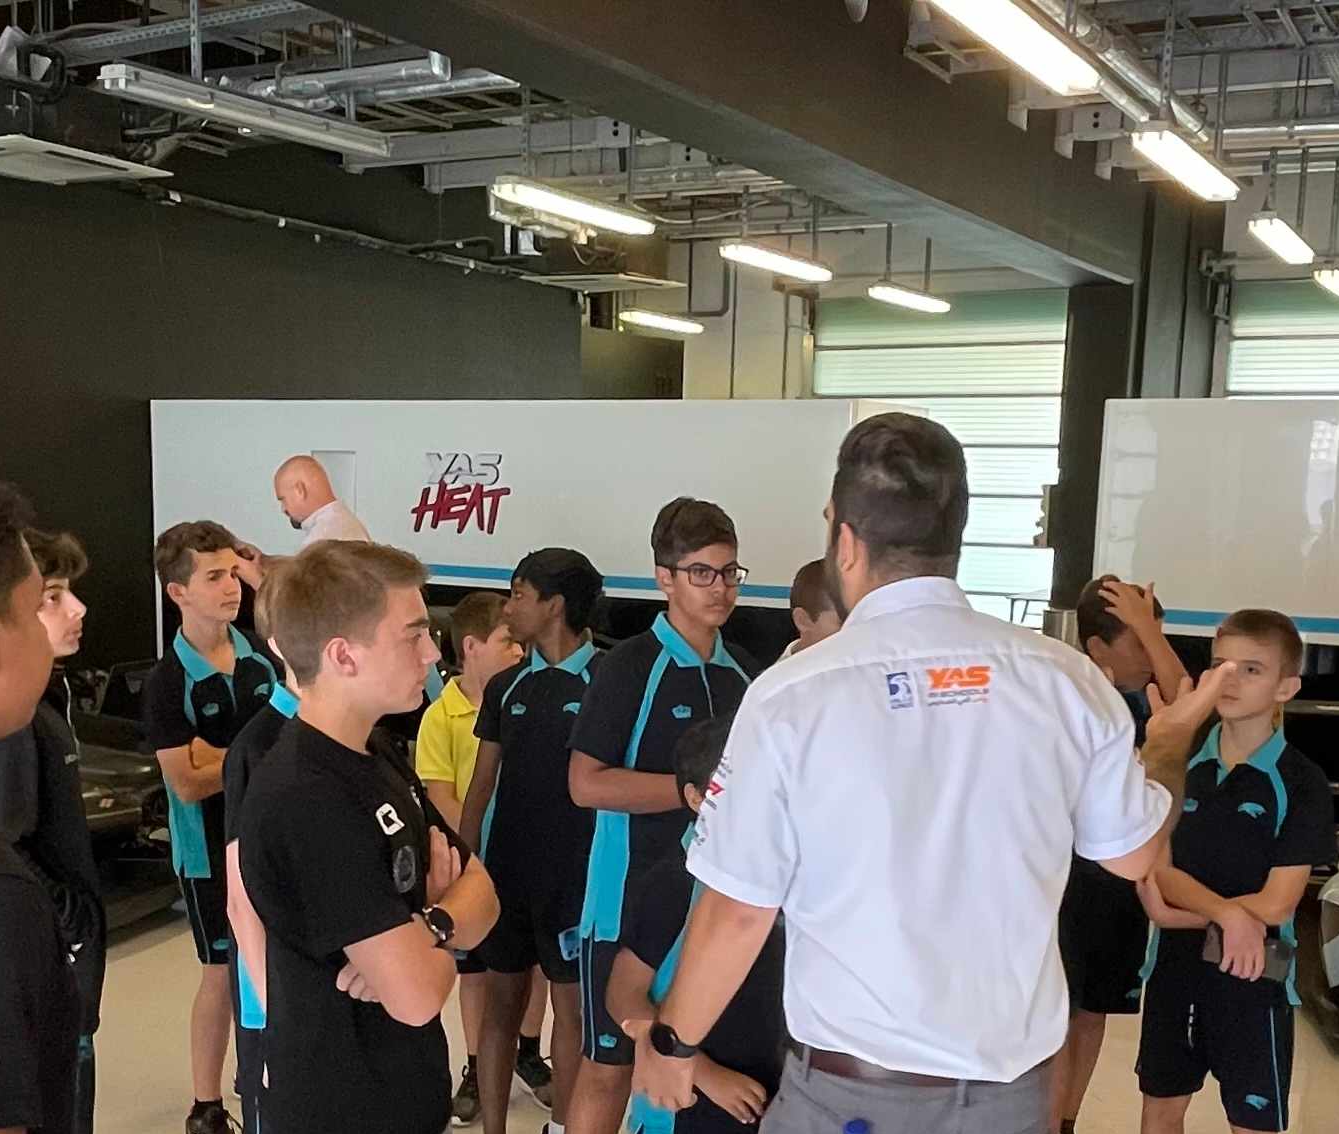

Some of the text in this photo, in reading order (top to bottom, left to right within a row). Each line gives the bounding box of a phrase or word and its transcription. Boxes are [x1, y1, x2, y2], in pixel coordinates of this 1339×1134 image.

[423, 452, 502, 485] YAS
[411, 481, 510, 535] HEAT
[925, 665, 991, 689] YAS
